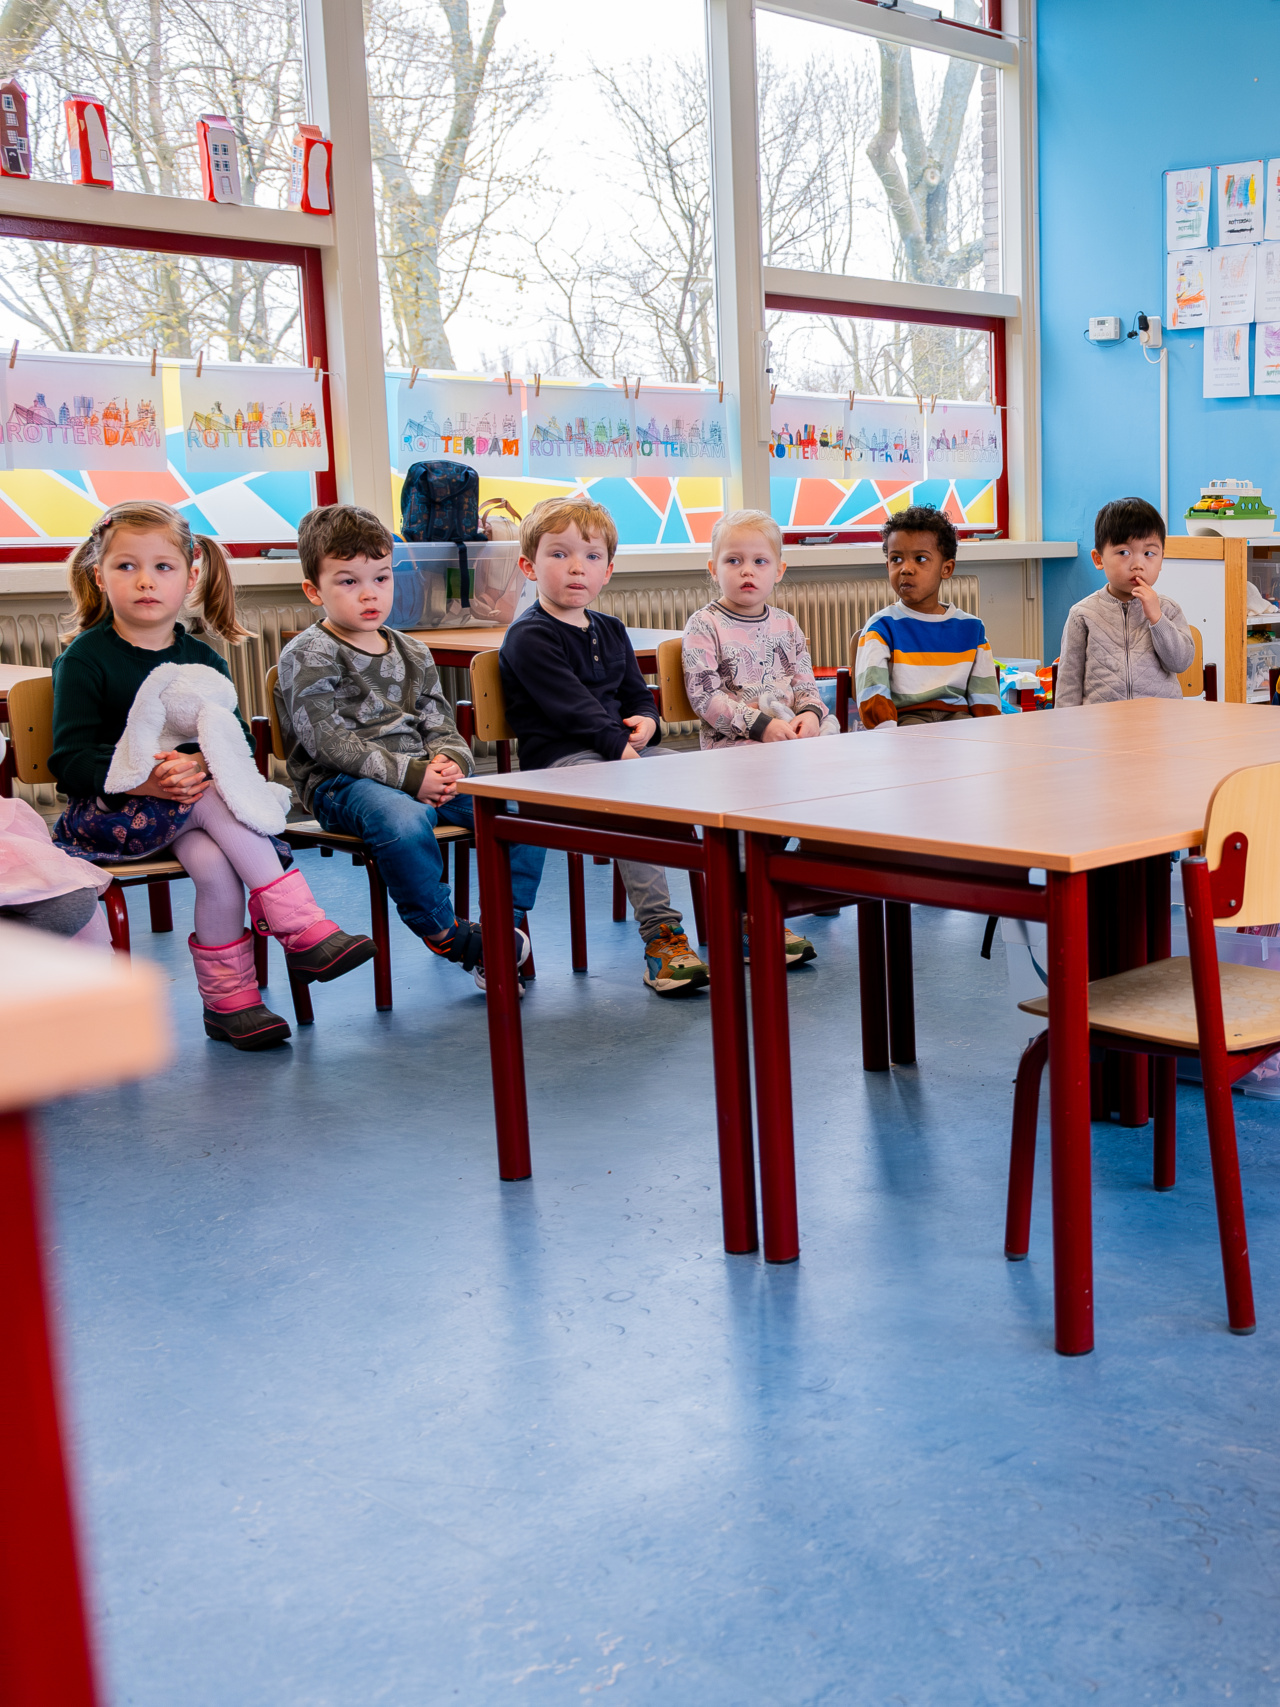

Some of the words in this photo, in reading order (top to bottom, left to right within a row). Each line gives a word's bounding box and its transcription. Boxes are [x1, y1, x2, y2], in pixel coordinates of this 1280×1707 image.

[6, 422, 161, 448] ROTTERDAM
[187, 428, 322, 448] ROTTERDAM
[400, 434, 520, 457] ROTTERDAM
[529, 439, 633, 458] ROTTERDAM
[844, 447, 921, 463] ROTTERDAM
[928, 448, 999, 463] ROTTERDAM
